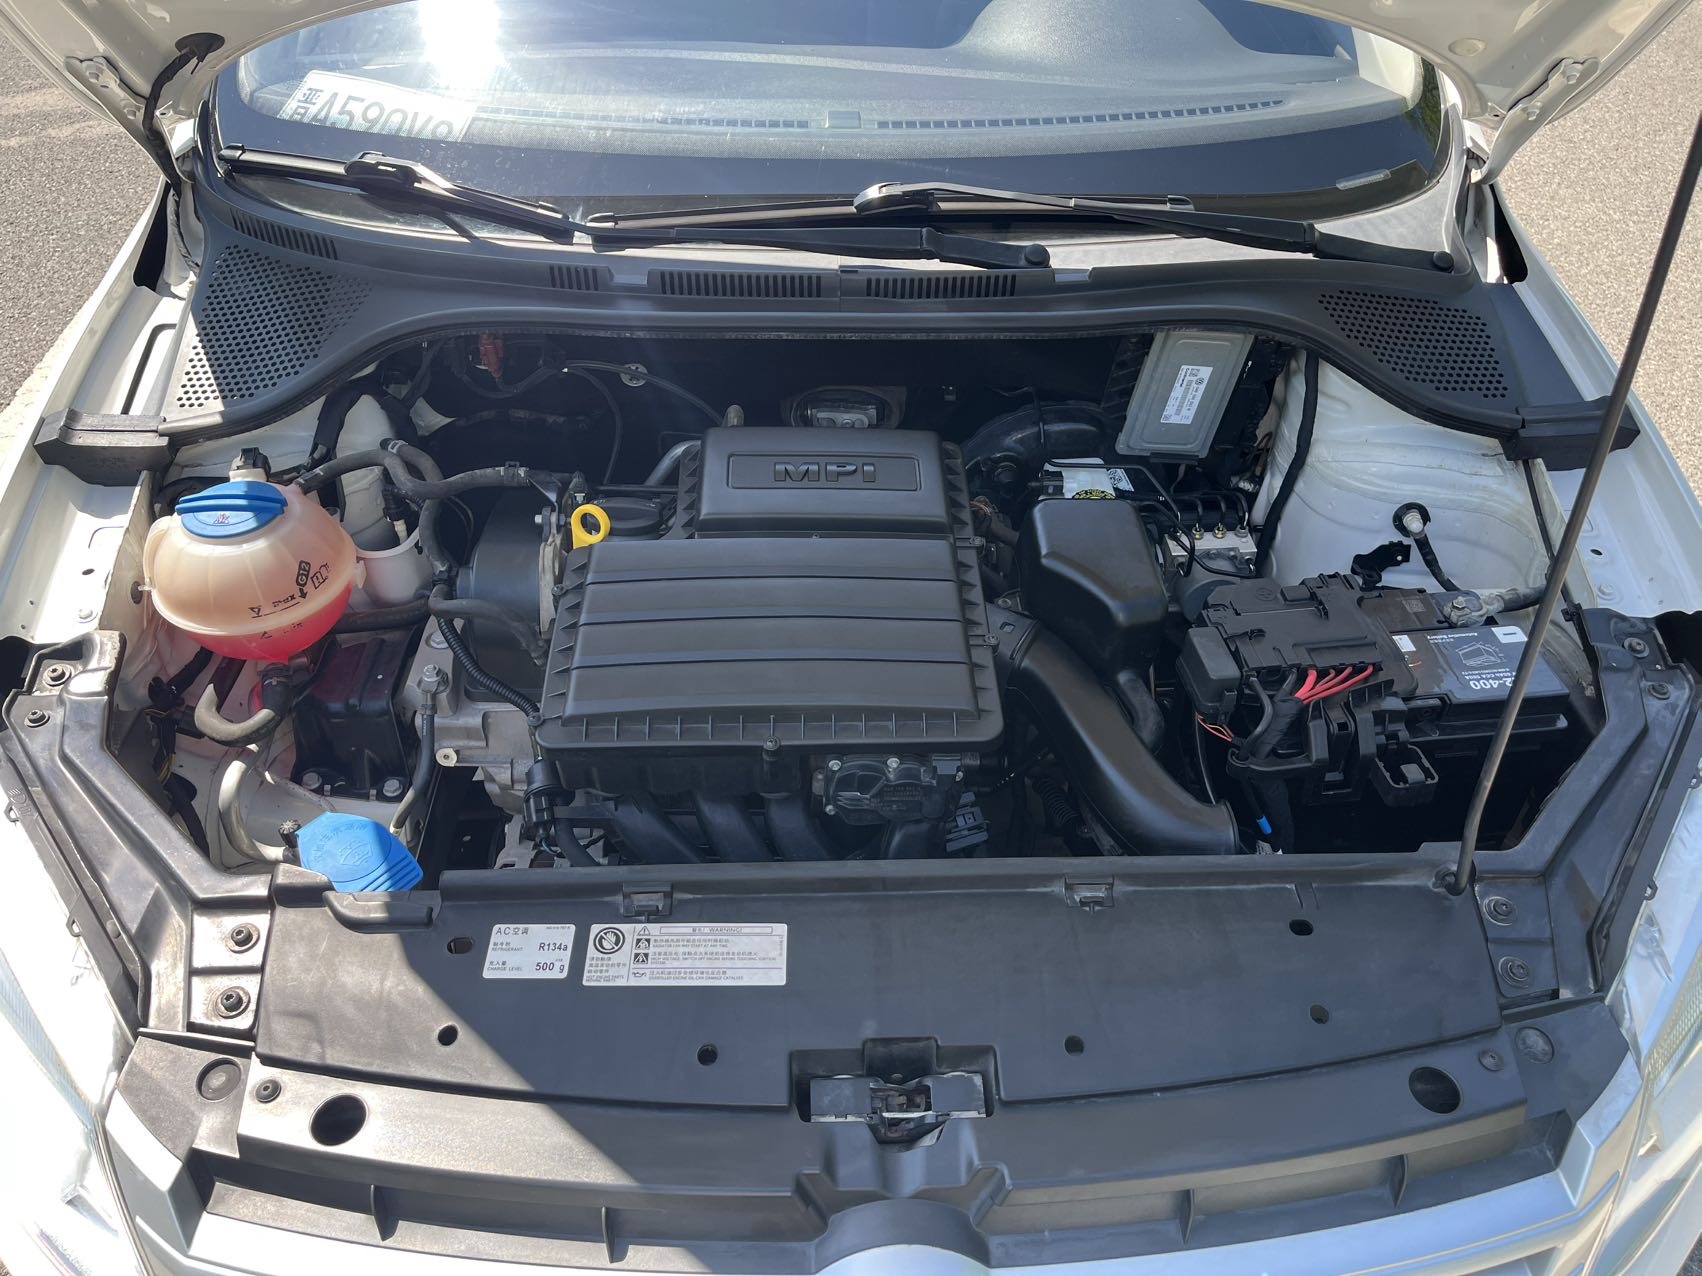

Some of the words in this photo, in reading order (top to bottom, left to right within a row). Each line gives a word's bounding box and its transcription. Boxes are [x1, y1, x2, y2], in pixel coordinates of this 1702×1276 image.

[773, 462, 876, 482] MPI
[298, 562, 310, 584] G12
[1469, 677, 1516, 690] 2-400
[538, 942, 568, 952] R134a
[535, 962, 554, 971] 500
[559, 964, 565, 973] g
